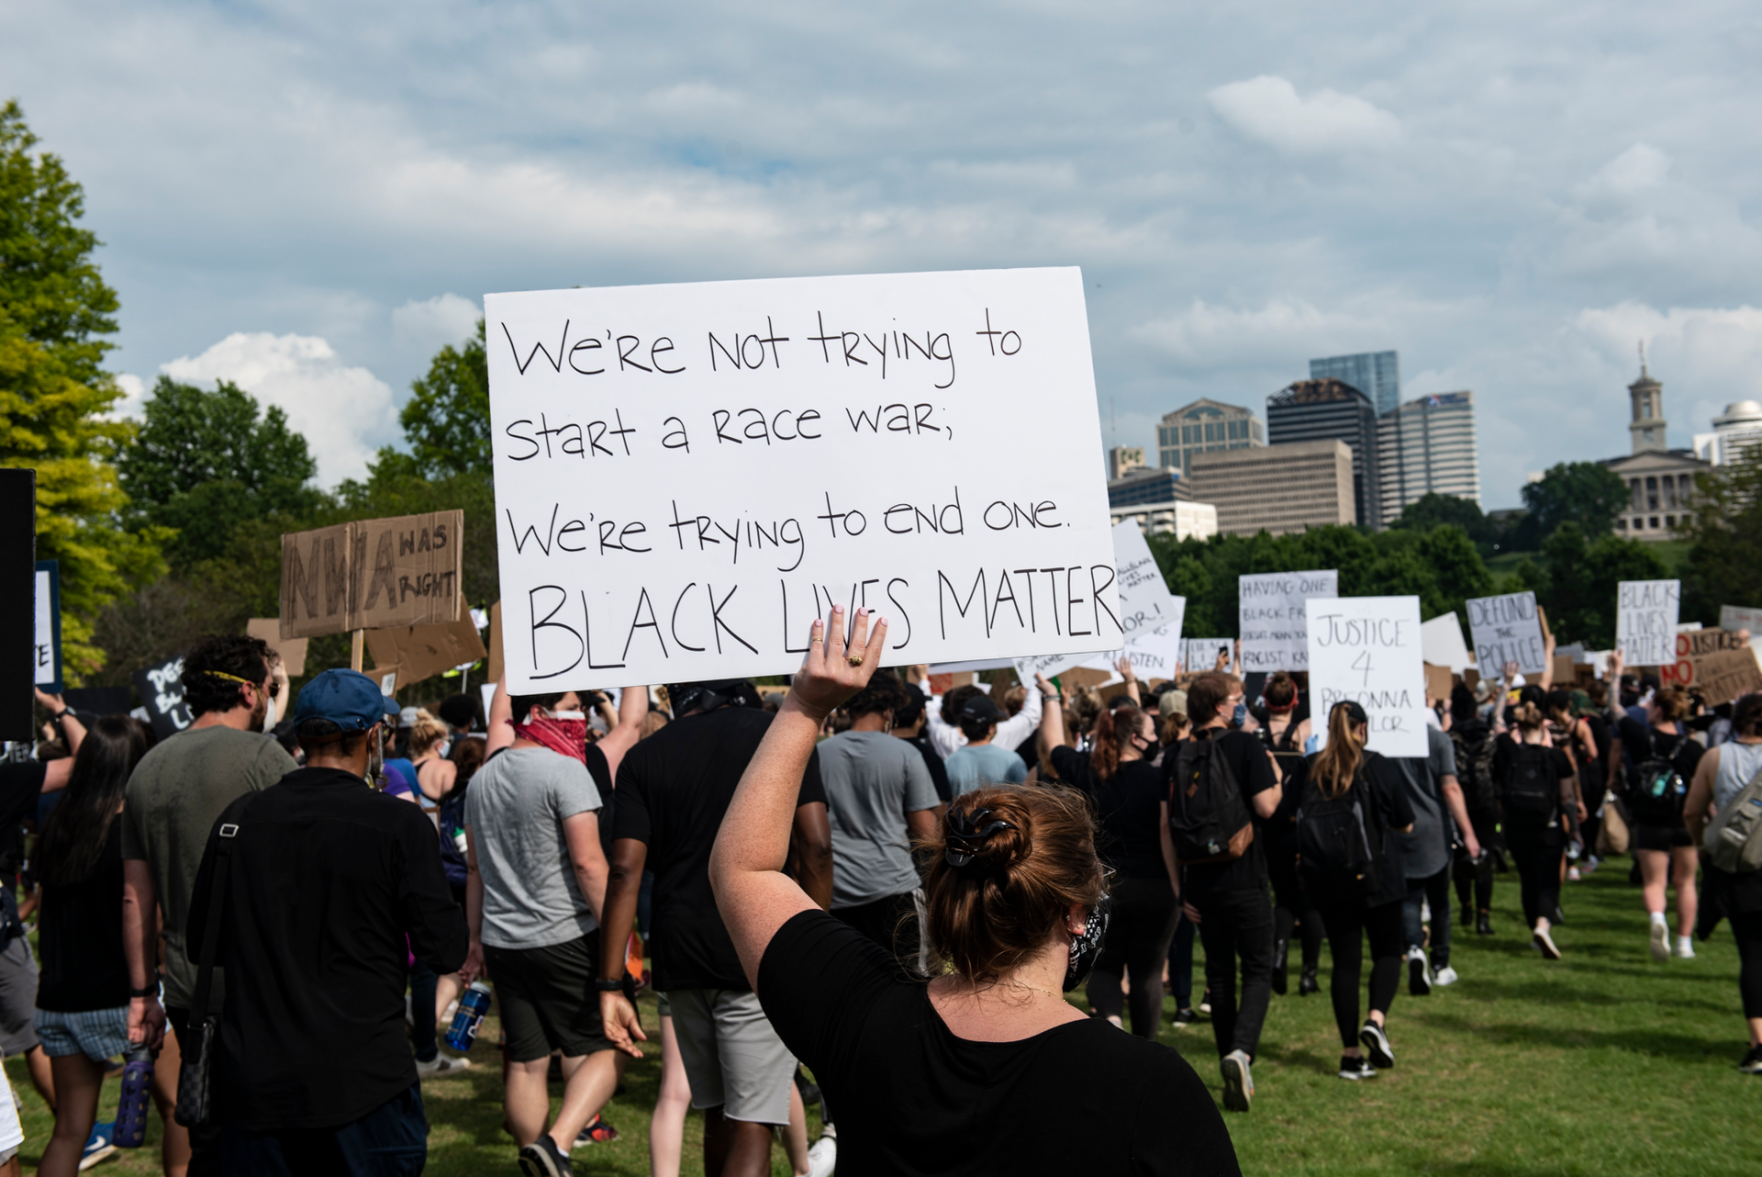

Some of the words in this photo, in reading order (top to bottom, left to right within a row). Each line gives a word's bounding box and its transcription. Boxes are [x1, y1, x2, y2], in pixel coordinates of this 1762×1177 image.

[976, 308, 1022, 356] to
[506, 408, 636, 461] start
[661, 416, 690, 454] a
[817, 491, 867, 537] to
[883, 486, 964, 536] end
[400, 524, 448, 557] WAS
[287, 529, 398, 624] NWA
[399, 570, 456, 603] RIGHT
[1242, 580, 1295, 598] HAVING
[1299, 578, 1330, 594] ONE
[1467, 593, 1537, 627] DEFUND
[1621, 583, 1680, 609] BLACK
[528, 582, 759, 680] BLACK
[937, 564, 1123, 640] MATTER
[1243, 607, 1283, 622] BLACK
[1316, 613, 1411, 648] JUSTICE
[1627, 610, 1669, 636] LIVES
[1495, 626, 1517, 639] THE
[1617, 634, 1676, 664] MATTER
[1350, 650, 1376, 688] 4
[1477, 635, 1545, 677] POLICE
[1661, 659, 1693, 687] NO
